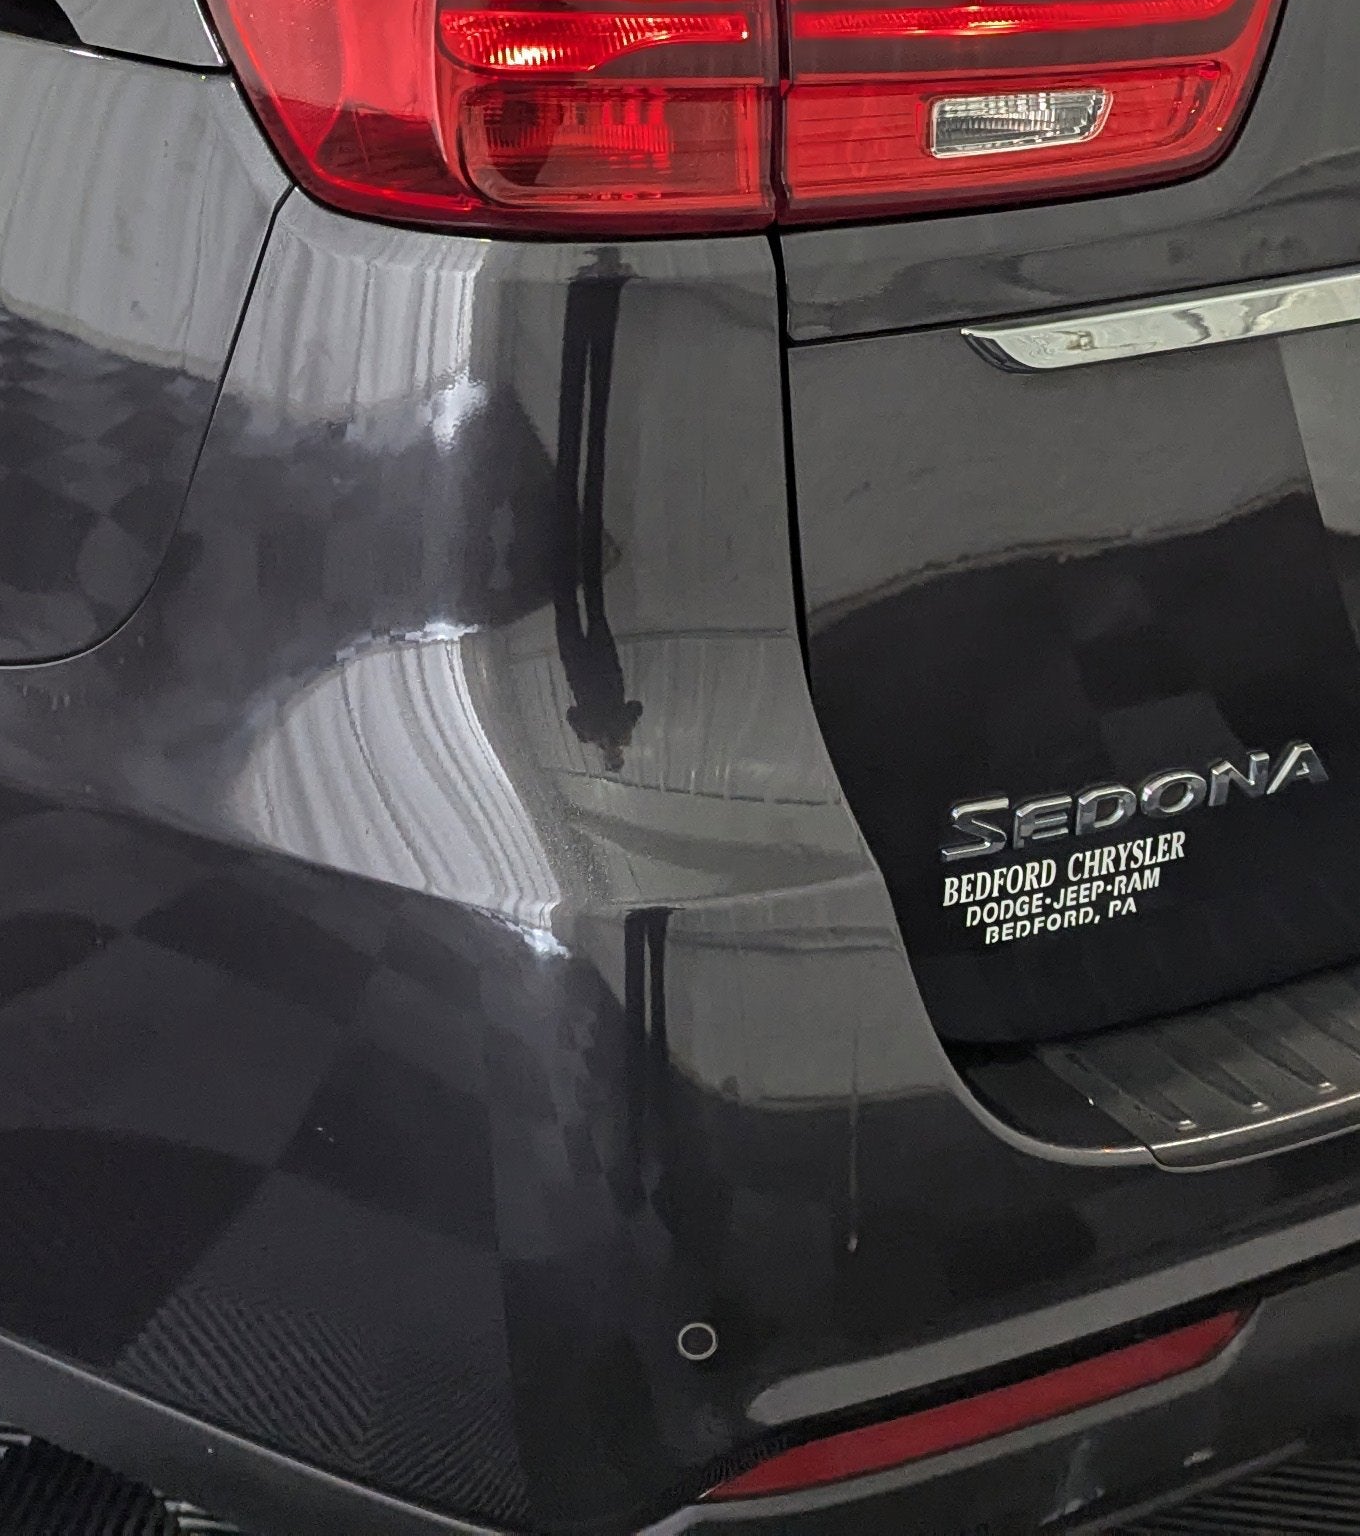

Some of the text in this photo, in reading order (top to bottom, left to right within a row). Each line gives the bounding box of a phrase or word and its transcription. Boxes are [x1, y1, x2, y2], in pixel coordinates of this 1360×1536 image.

[941, 741, 1330, 862] SEDONA
[942, 830, 1186, 907] BEDFORD CHRYSLER
[985, 896, 1137, 945] BEDFORD, PA
